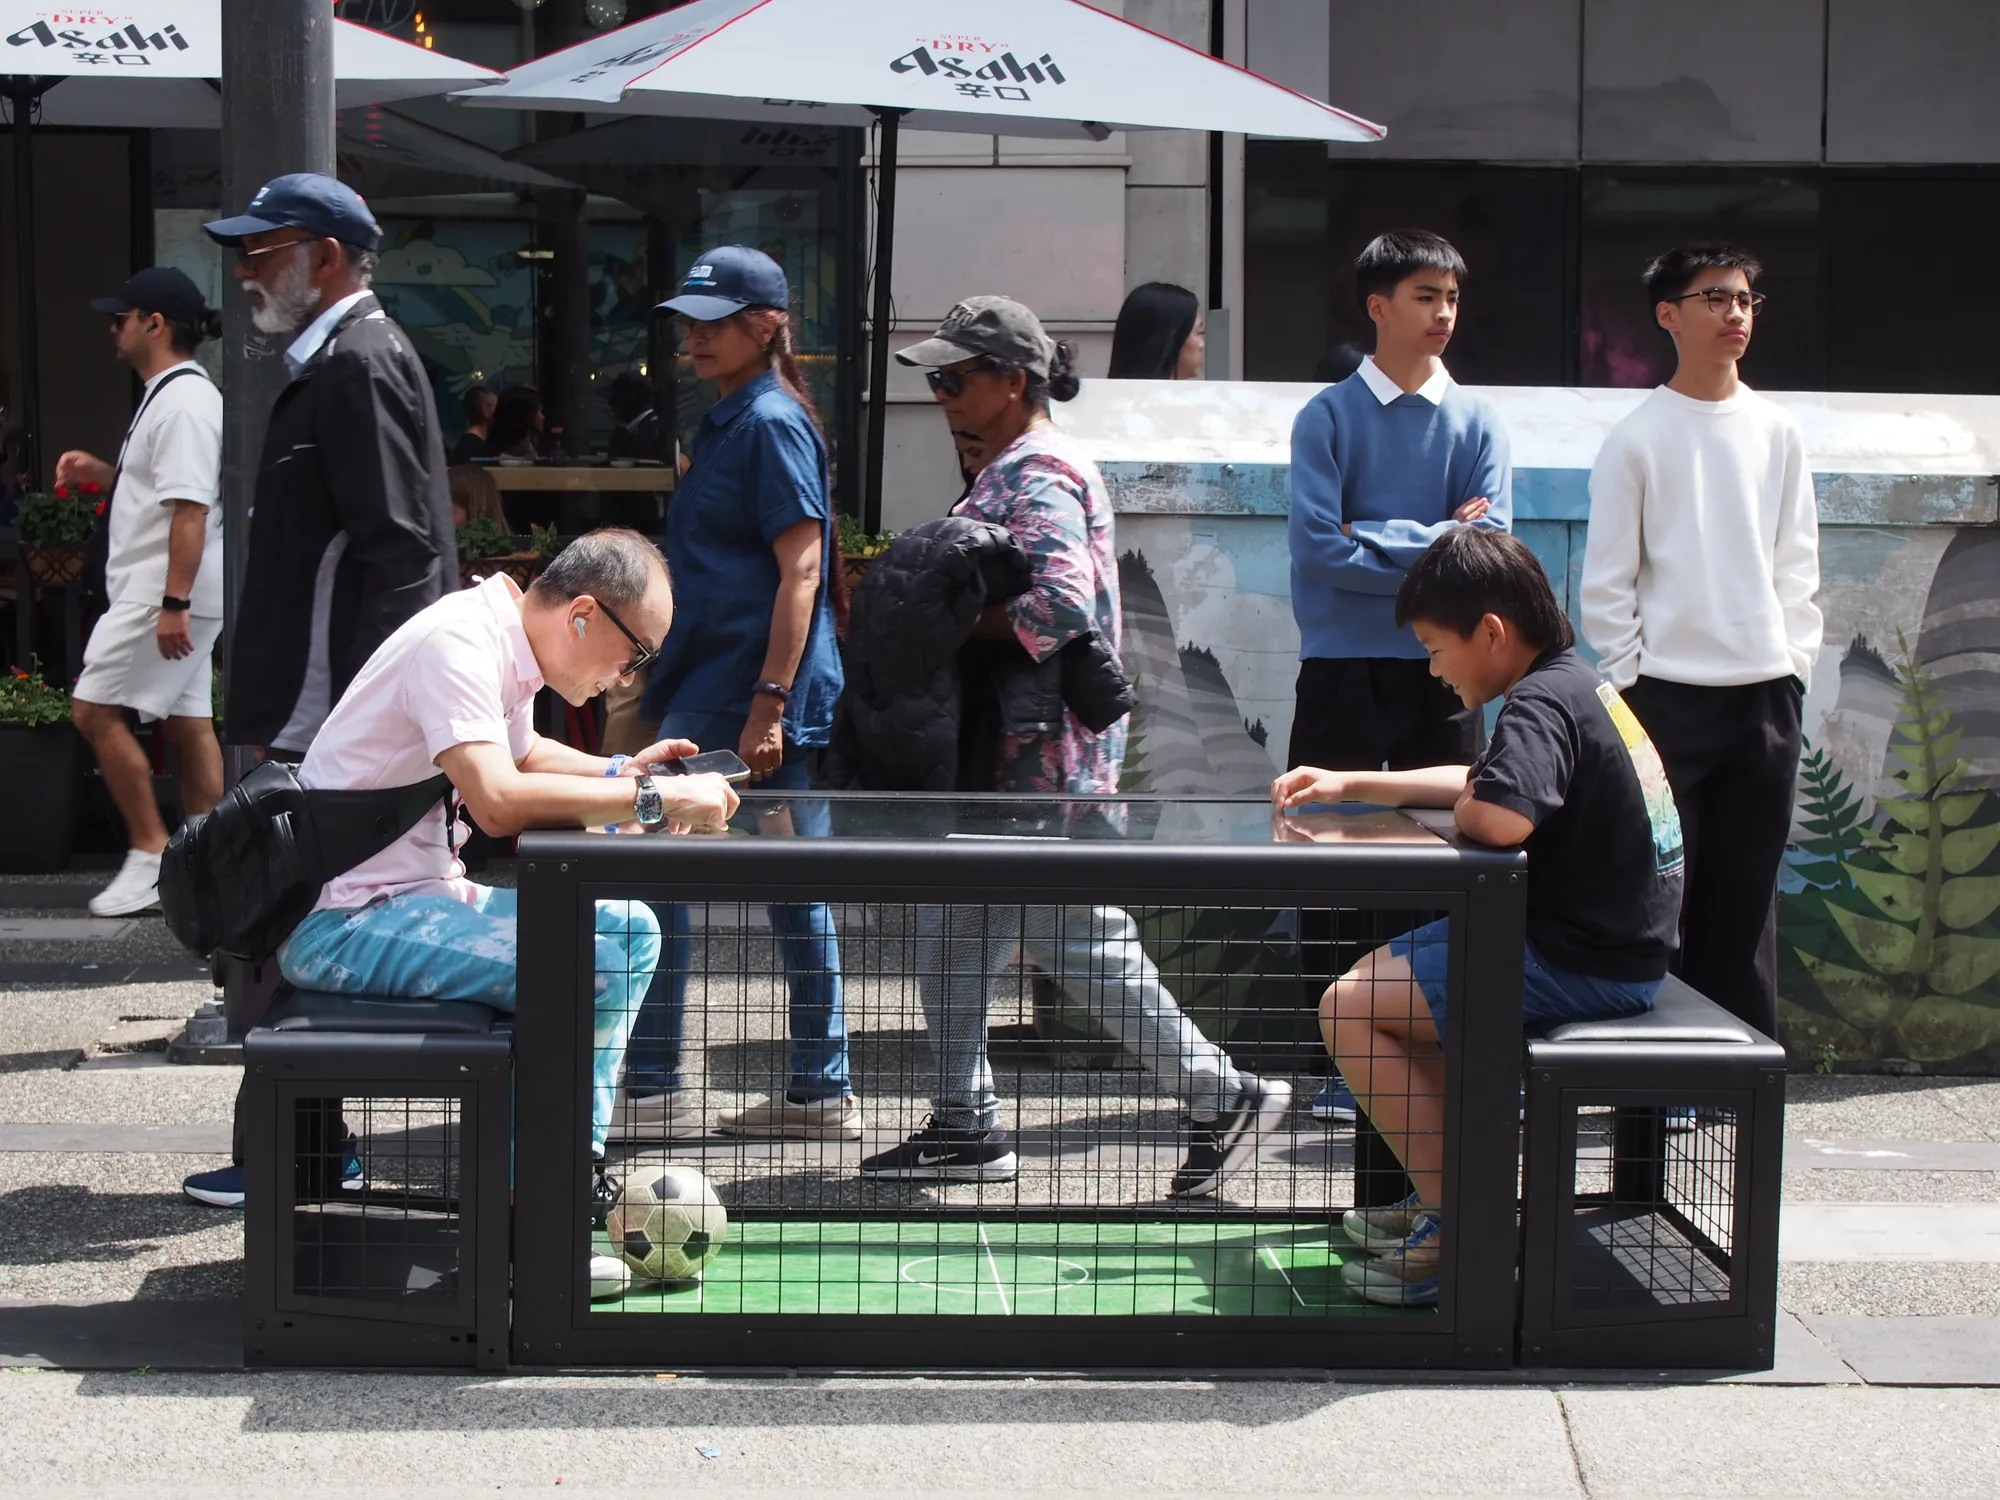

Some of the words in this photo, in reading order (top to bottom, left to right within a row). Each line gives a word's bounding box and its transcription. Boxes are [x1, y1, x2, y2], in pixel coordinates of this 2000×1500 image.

[6, 20, 189, 51] Asahi
[72, 52, 151, 65] 辛口
[890, 46, 1066, 85] Asahi
[955, 82, 1031, 101] 辛口
